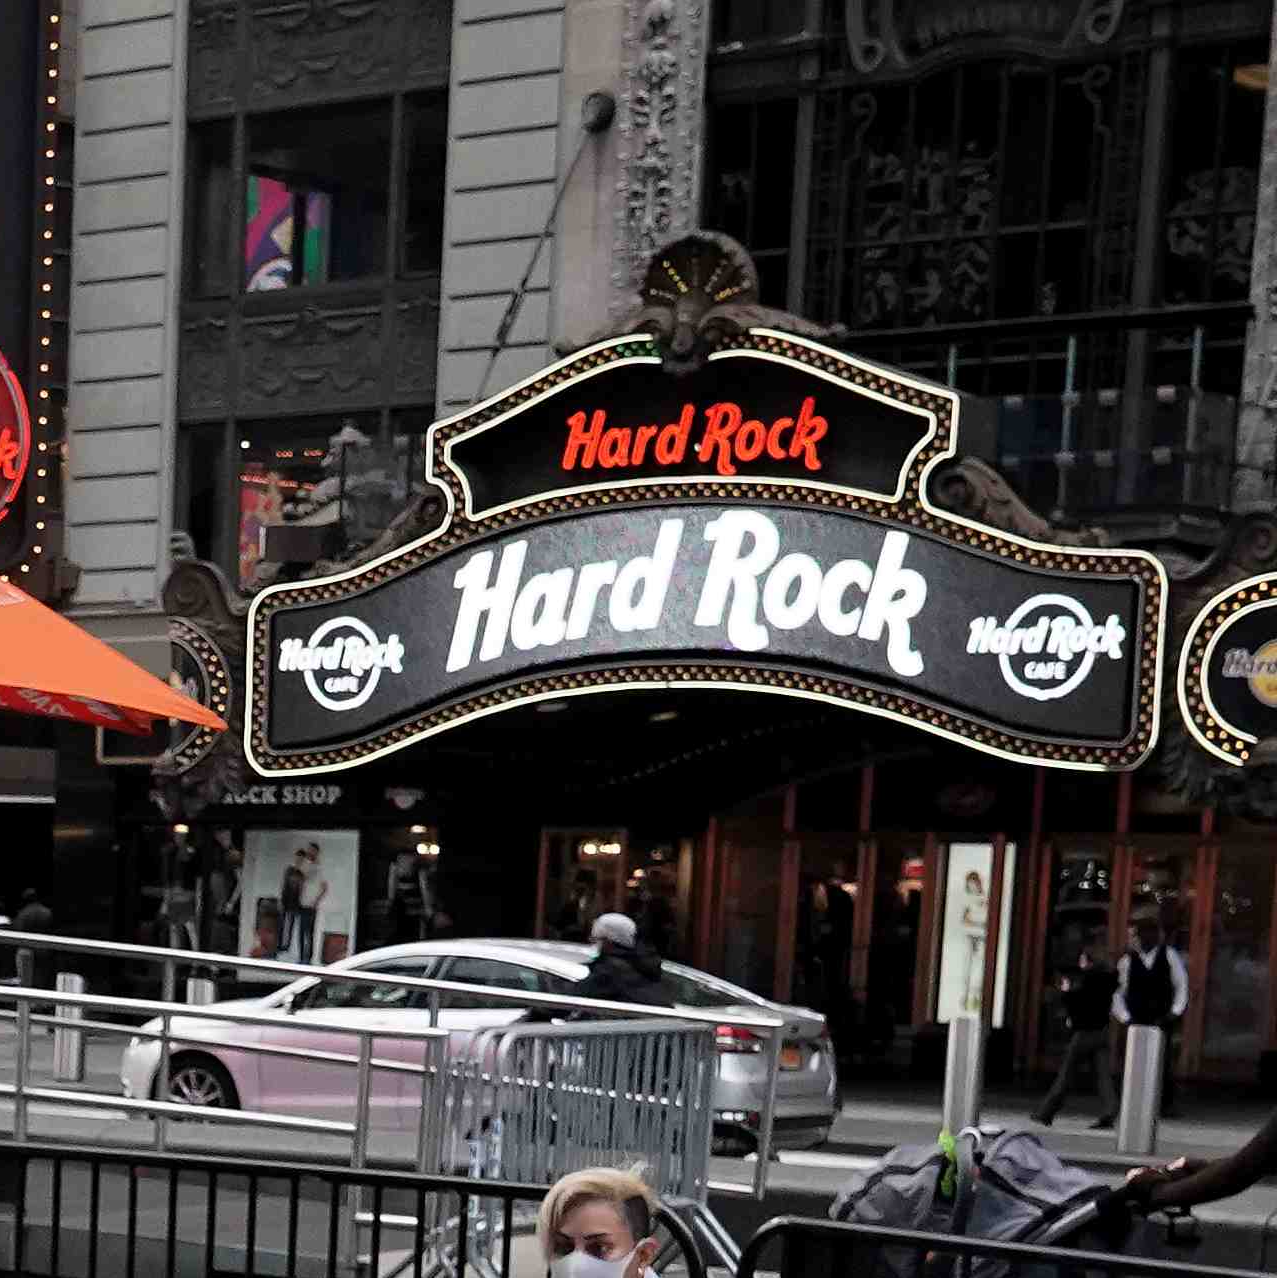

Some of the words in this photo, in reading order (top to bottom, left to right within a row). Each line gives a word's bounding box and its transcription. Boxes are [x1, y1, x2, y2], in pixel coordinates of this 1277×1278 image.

[562, 403, 696, 472] Hard
[698, 396, 830, 477] Rock
[445, 517, 684, 674] Hard
[693, 509, 928, 678] Rock
[278, 637, 345, 672] Hard
[341, 633, 405, 677] Rock
[966, 615, 1050, 656] Hard
[1045, 613, 1126, 661] Rock
[1023, 660, 1067, 680] CAFE
[282, 785, 342, 805] SHOP
